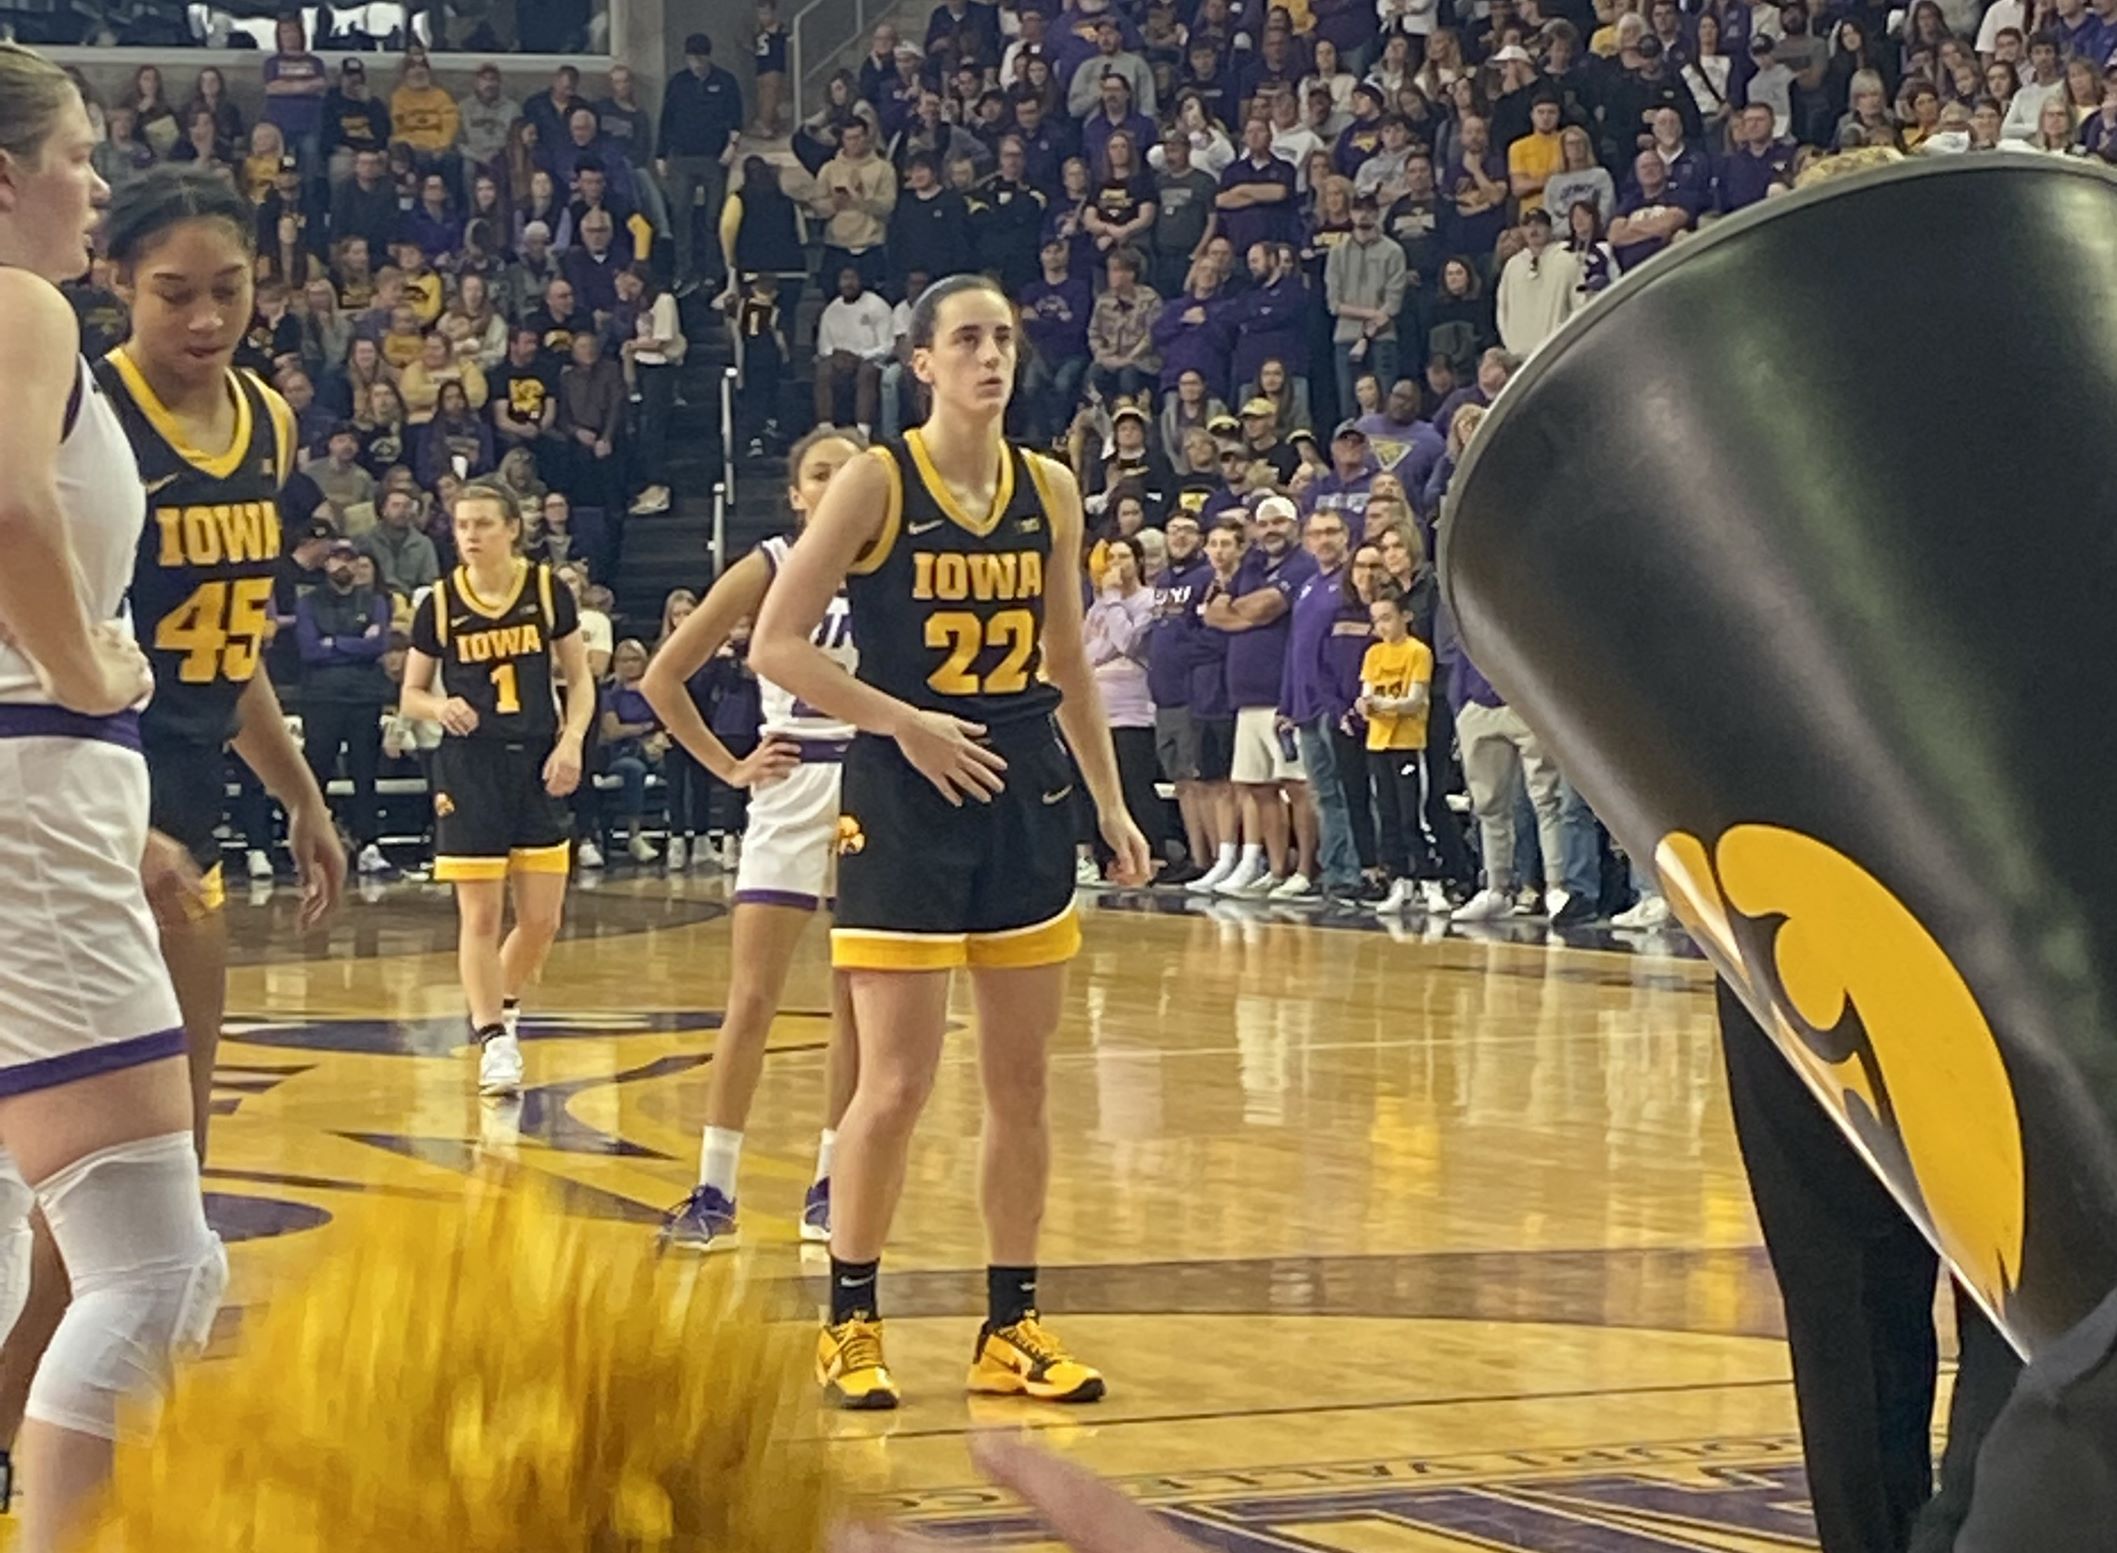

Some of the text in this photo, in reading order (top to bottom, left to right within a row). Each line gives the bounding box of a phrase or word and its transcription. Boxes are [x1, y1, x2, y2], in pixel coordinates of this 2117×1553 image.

[912, 552, 1042, 600] IOWA
[154, 576, 276, 683] 45
[455, 624, 542, 664] IOWA
[924, 608, 1035, 695] 22
[490, 663, 520, 714] 1
